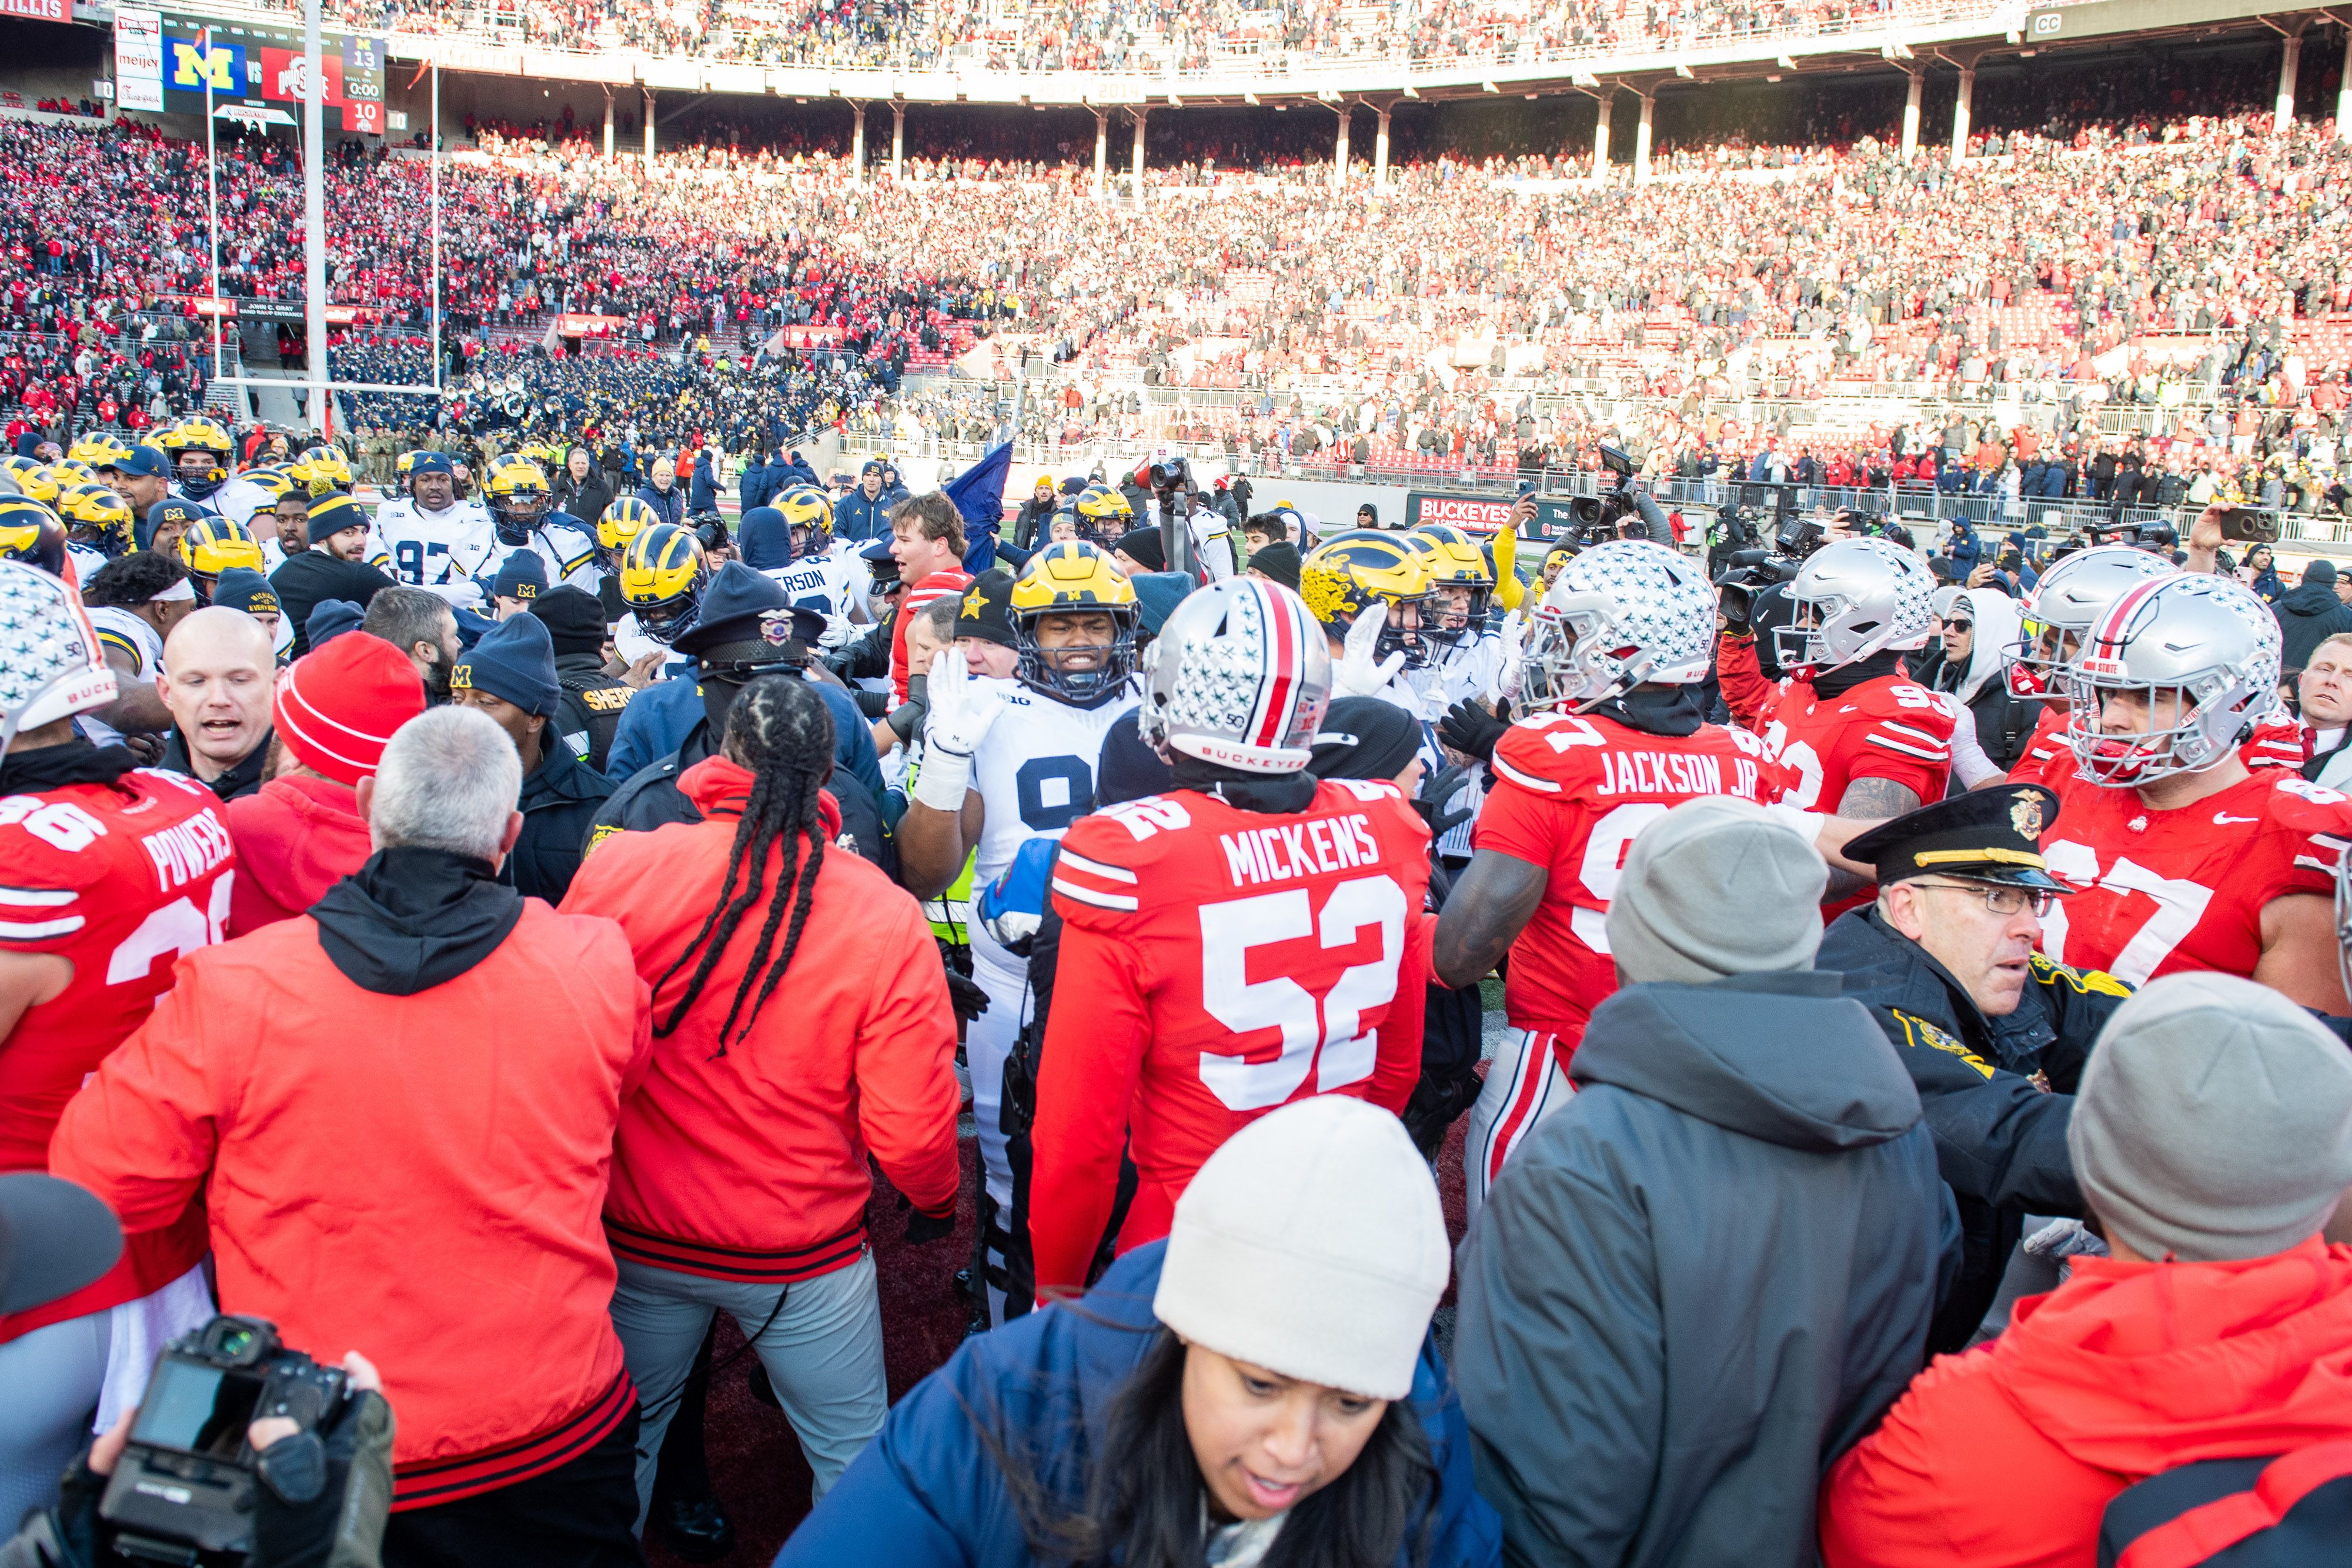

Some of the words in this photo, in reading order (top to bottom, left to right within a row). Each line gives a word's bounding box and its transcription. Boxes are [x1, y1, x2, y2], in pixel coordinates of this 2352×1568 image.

[2038, 17, 2058, 31] CC
[119, 54, 159, 69] meijer
[354, 51, 377, 68] 13
[246, 60, 262, 83] VS
[349, 83, 379, 97] 0:00
[1098, 84, 1138, 98] 2014
[354, 102, 376, 120] 10
[1421, 500, 1512, 523] BUCKEYES
[1552, 509, 1568, 519] The
[396, 540, 451, 586] 97
[517, 584, 536, 598] M
[1067, 590, 1082, 601] M
[450, 665, 472, 688] M
[2097, 663, 2119, 674] STATE
[1225, 713, 1245, 728] 50
[1202, 746, 1305, 768] BUCKEYES
[1596, 751, 1722, 796] JACKSON
[1730, 757, 1759, 800] JR
[141, 806, 232, 892] POWERS
[1220, 814, 1379, 887] MICKENS
[1198, 874, 1408, 1111] 52
